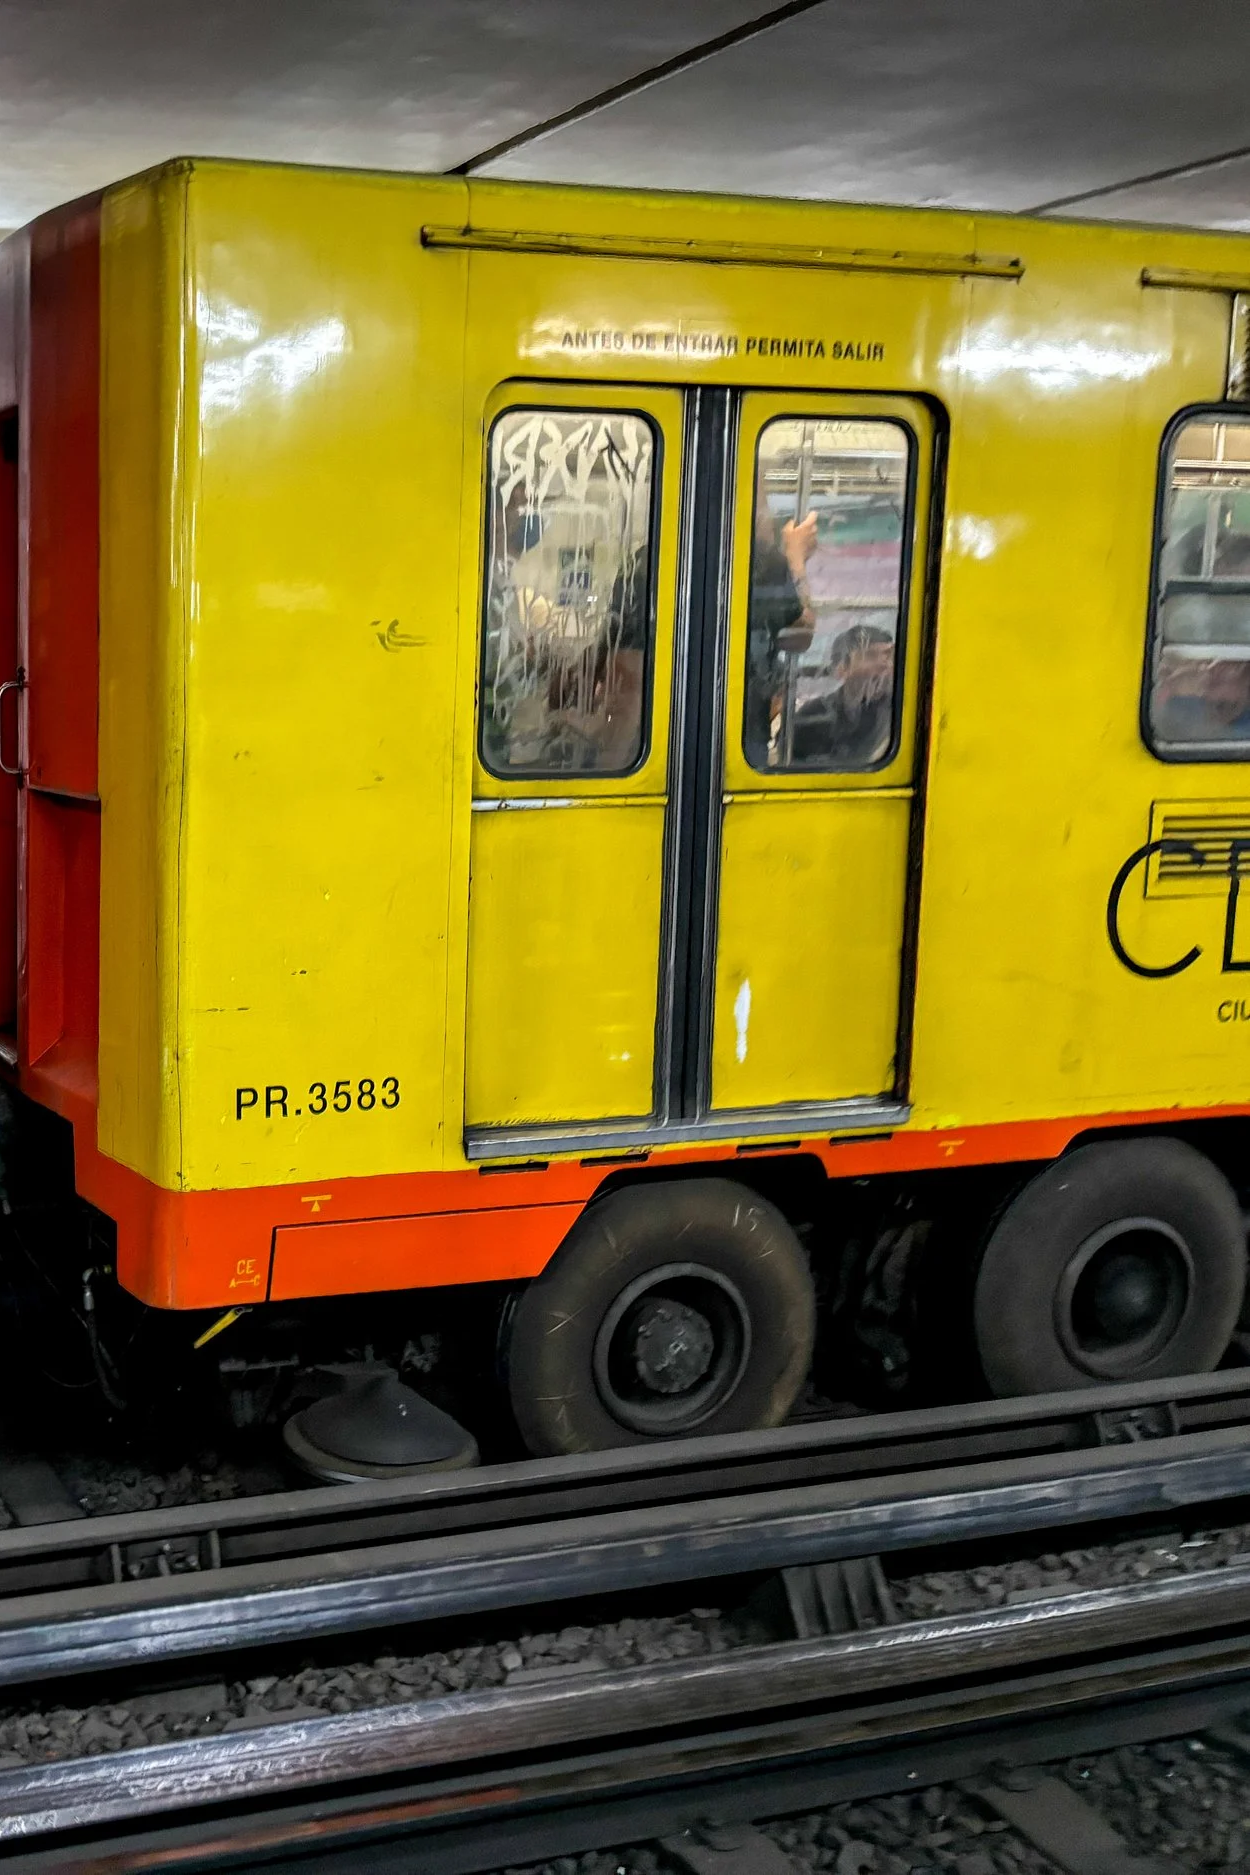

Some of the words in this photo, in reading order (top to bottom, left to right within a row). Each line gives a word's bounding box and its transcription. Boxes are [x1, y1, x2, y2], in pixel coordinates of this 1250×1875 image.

[561, 330, 624, 350] ANTES
[632, 332, 656, 351] DE
[664, 332, 738, 356] ENTRAR
[746, 336, 825, 359] PERMITA
[832, 340, 885, 361] SALIR
[236, 1077, 400, 1121] PR.3583
[236, 1259, 256, 1275] CE
